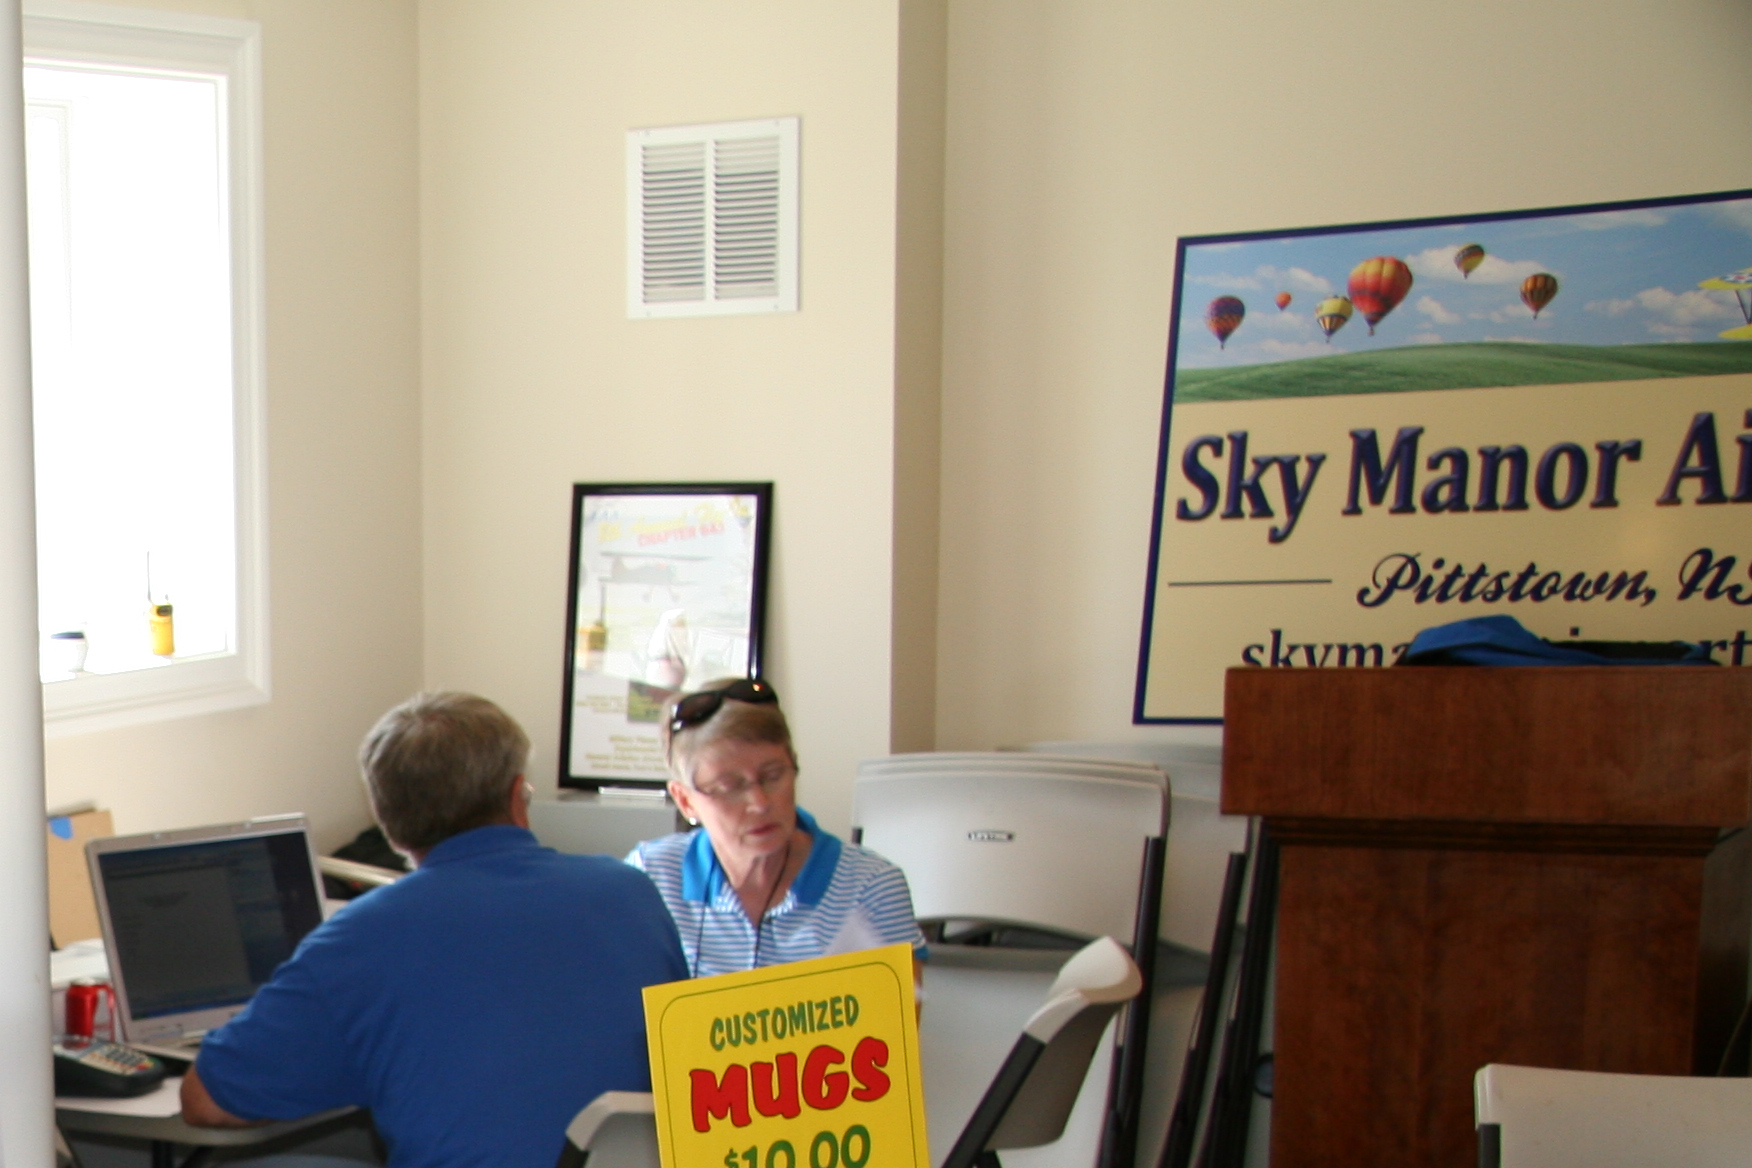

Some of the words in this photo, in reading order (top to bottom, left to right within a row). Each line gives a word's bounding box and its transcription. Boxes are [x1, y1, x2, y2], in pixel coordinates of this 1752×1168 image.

[1176, 430, 1327, 544] Sky
[1342, 426, 1643, 516] Manor
[1355, 550, 1657, 608] Pittstown,
[710, 994, 860, 1051] CUSTOMIZED
[689, 1036, 891, 1133] MUGS
